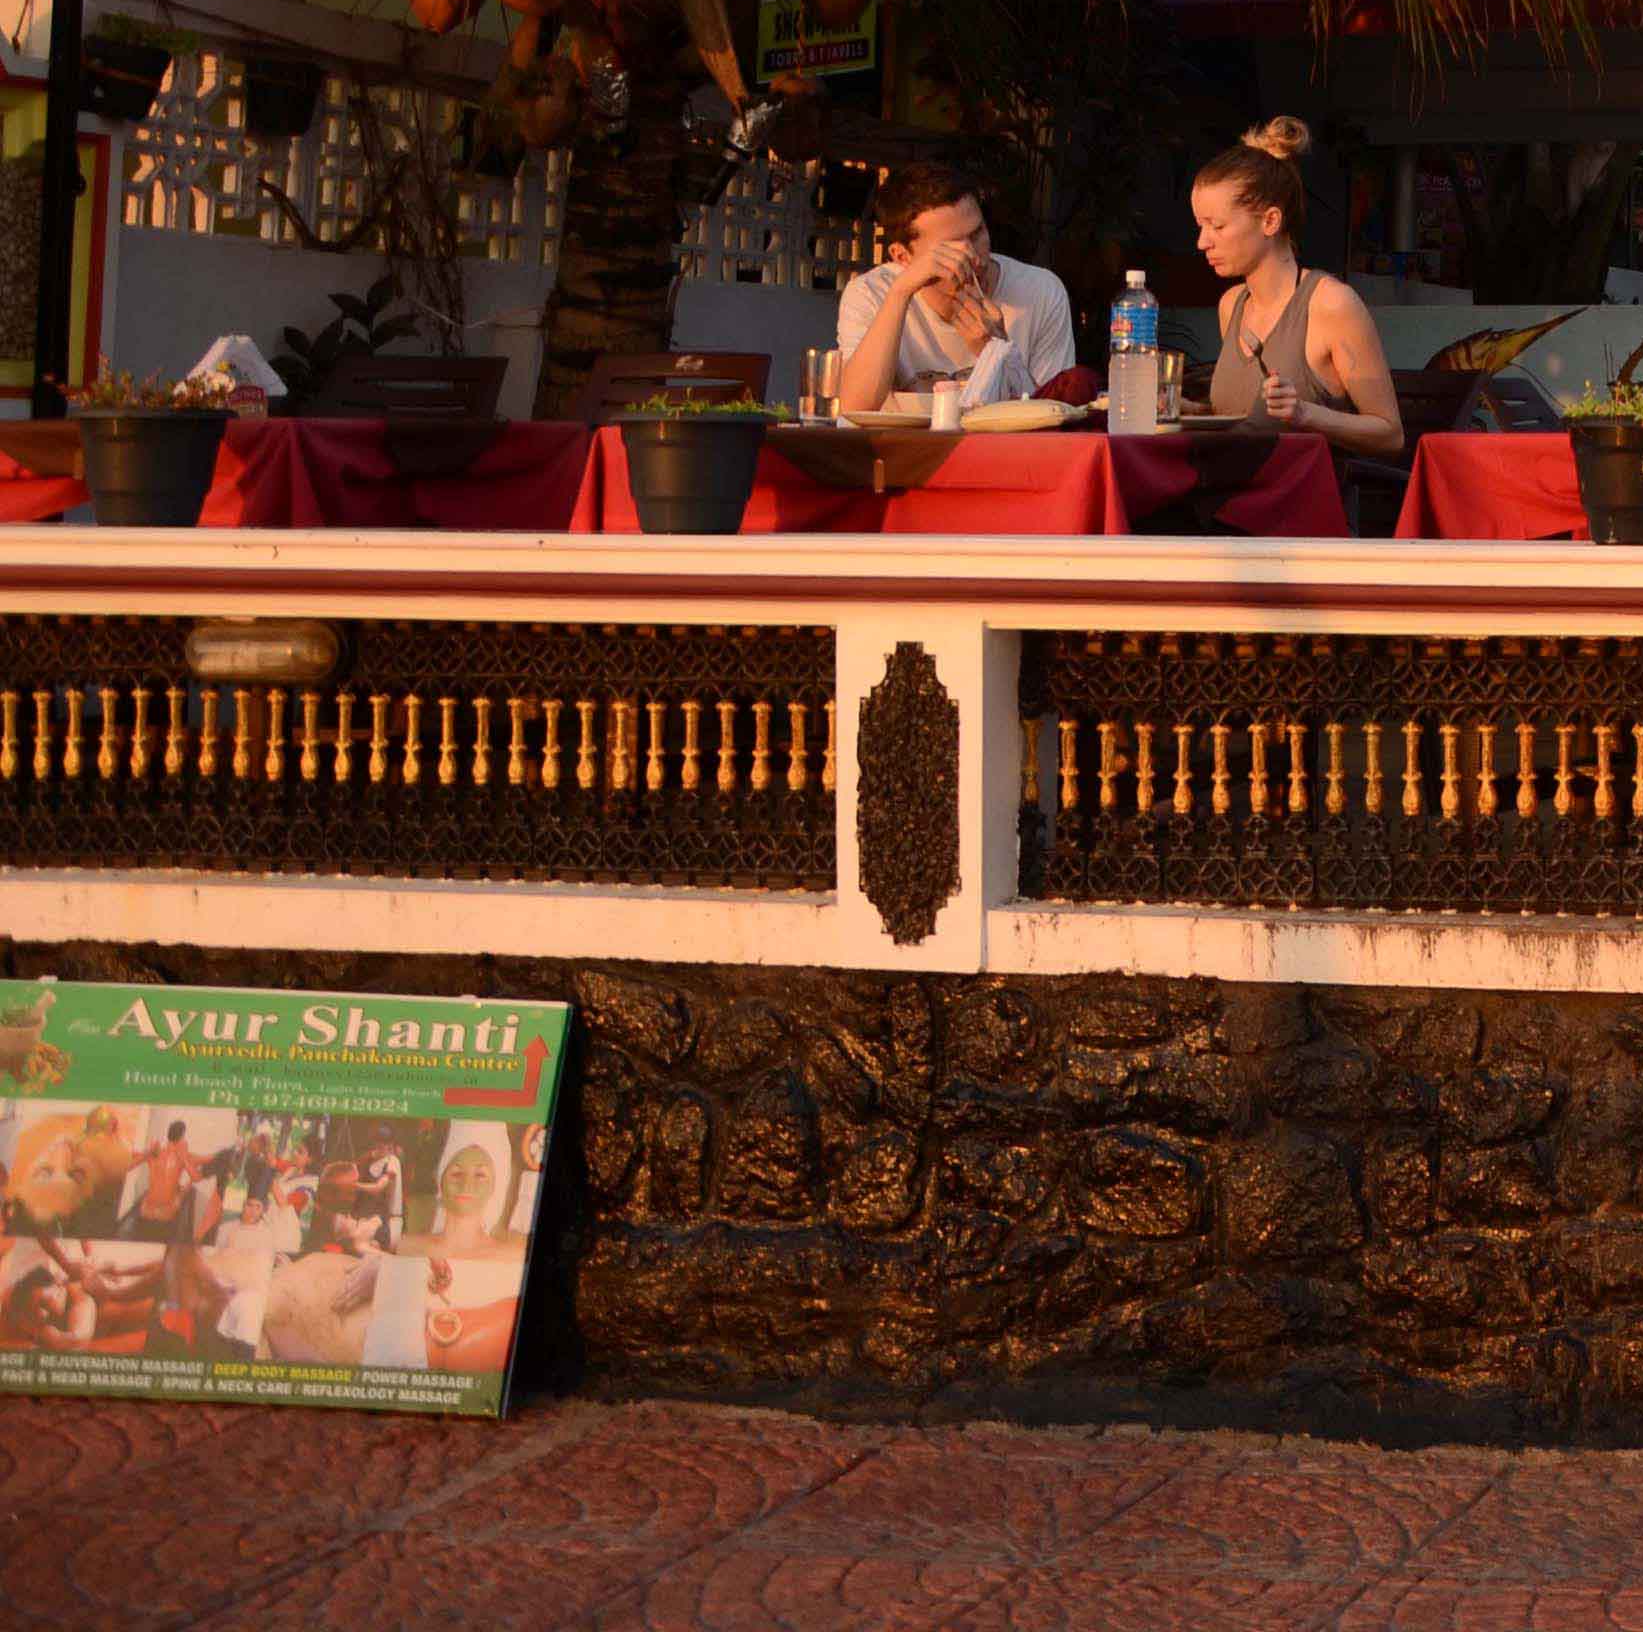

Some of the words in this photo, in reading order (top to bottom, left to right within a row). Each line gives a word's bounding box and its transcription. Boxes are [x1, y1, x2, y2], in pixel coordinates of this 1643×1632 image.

[107, 996, 279, 1051] Ayur
[298, 1004, 520, 1056] Shanti
[176, 1040, 280, 1062] Ayurvedic
[288, 1045, 438, 1069] Panchakarma
[444, 1052, 520, 1073] Centre
[90, 1373, 153, 1390] MASSAGE
[302, 1384, 395, 1402] REFLEXOLOGY
[397, 1388, 462, 1406] MASSAGE
[141, 1359, 205, 1376] MASSAGE
[213, 1363, 249, 1377] DEEP
[251, 1364, 285, 1379] BODY
[289, 1366, 352, 1383] MASSAGE
[361, 1371, 409, 1386] POWER
[411, 1374, 473, 1390] MASSAGE
